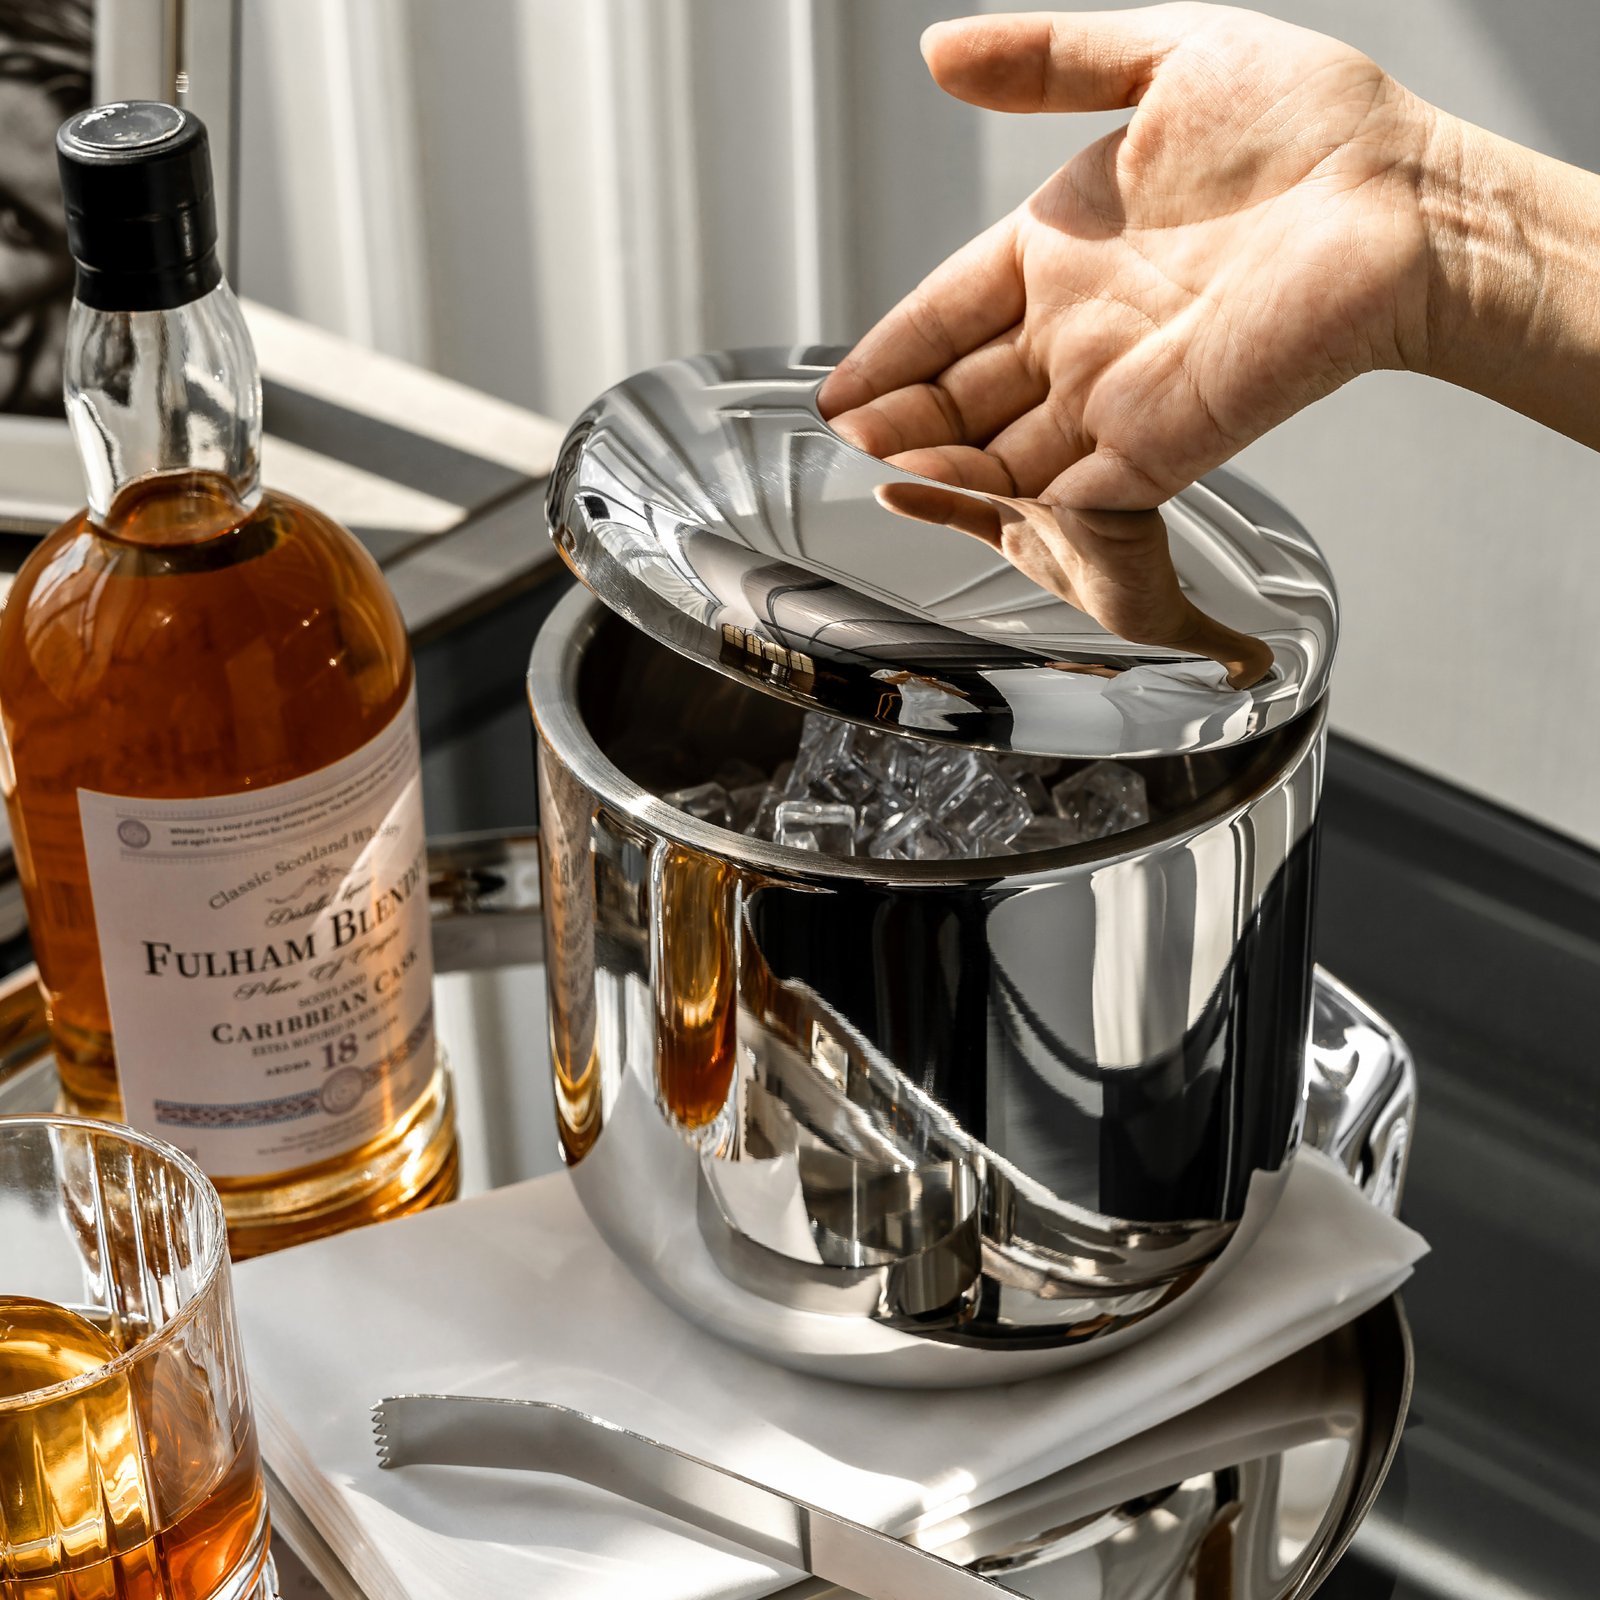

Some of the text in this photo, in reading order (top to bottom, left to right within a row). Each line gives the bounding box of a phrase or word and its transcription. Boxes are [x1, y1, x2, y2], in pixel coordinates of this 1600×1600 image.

[208, 870, 273, 911] Classic
[274, 835, 349, 877] Scotland
[141, 934, 316, 979] FULHAM
[298, 972, 367, 1009] SCOTLAND
[211, 988, 368, 1045] CARIBBEAN
[266, 1060, 312, 1076] AROMA
[321, 1033, 359, 1072] 18
